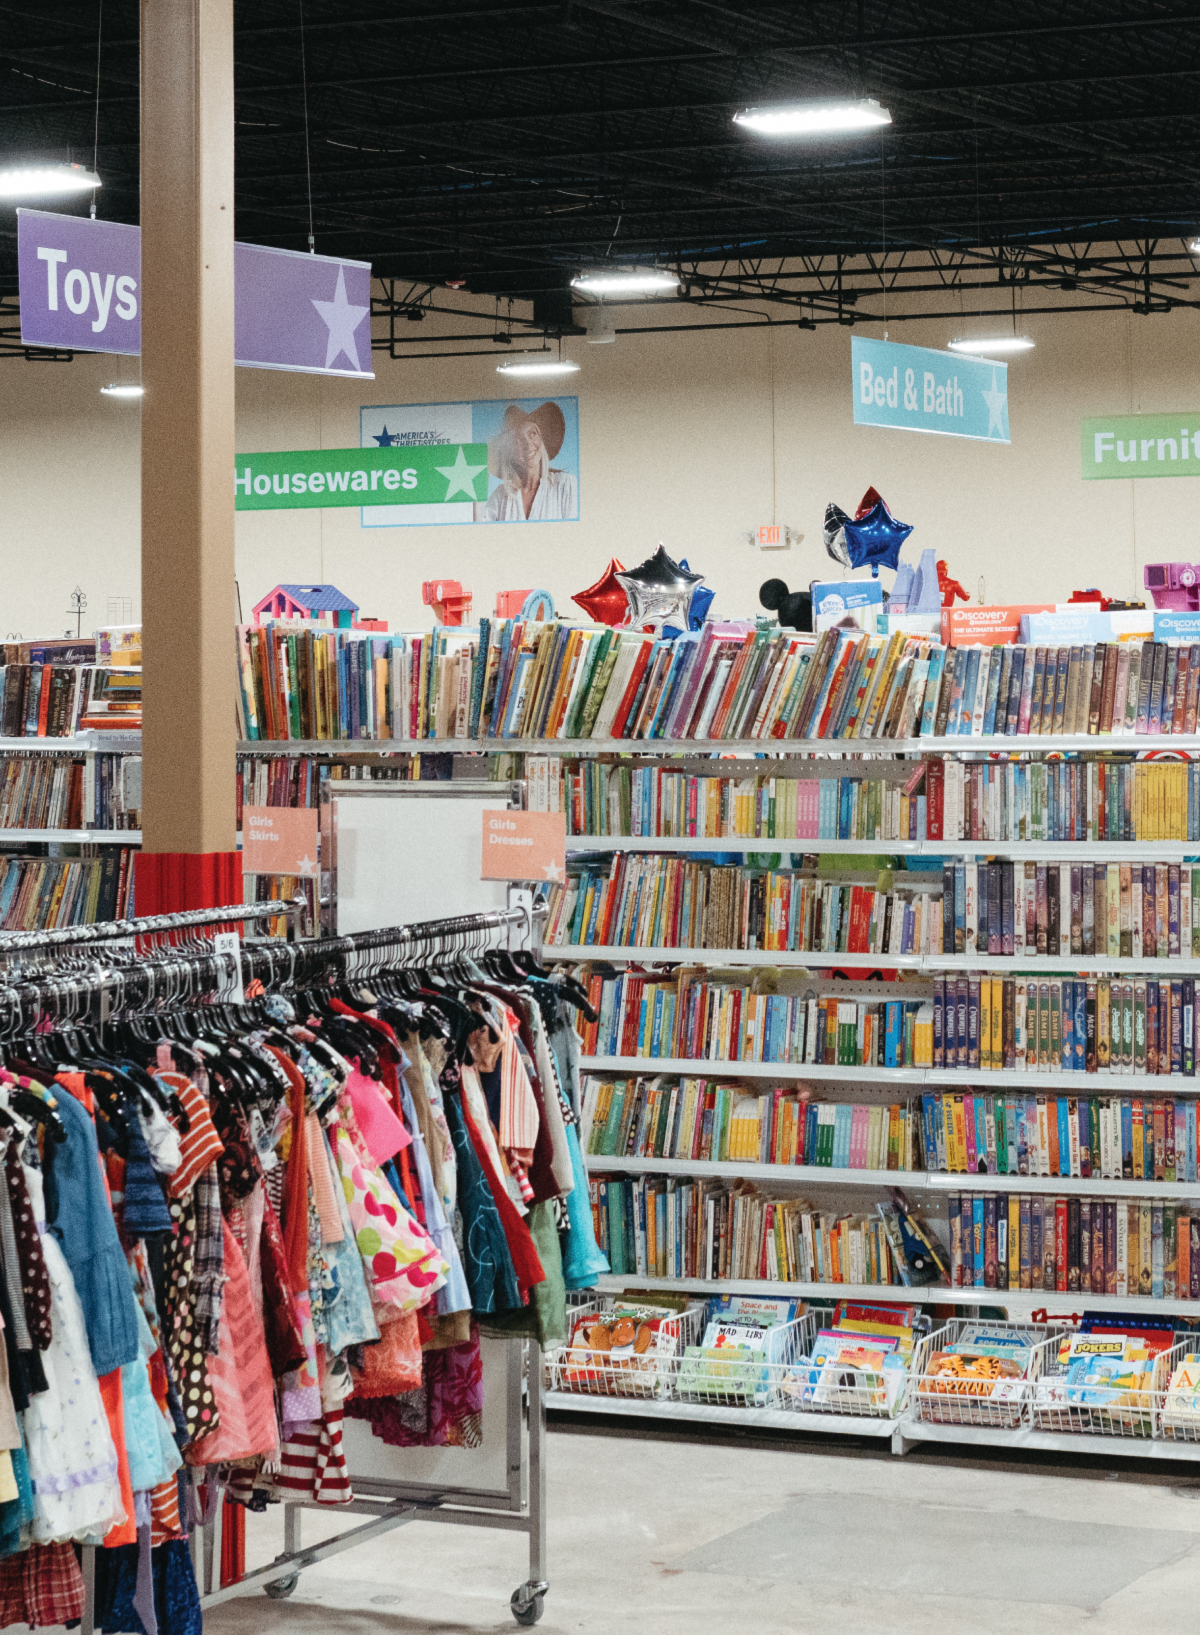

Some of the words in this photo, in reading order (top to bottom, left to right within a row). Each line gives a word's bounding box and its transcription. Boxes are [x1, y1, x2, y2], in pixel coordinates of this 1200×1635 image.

[37, 246, 138, 333] Toys
[860, 361, 898, 410] Bed
[903, 368, 920, 412] &
[923, 372, 964, 418] Bath
[395, 430, 435, 441] AMERICA'S
[1094, 431, 1200, 465] Furnit
[234, 466, 418, 497] Housewares
[760, 525, 782, 544] EXIT
[952, 610, 1008, 622] Discovery
[350, 643, 358, 674] SHAPES
[1046, 676, 1054, 692] Peter
[1138, 680, 1151, 706] FANTASIA
[1150, 680, 1163, 707] FANTASIA
[29, 683, 39, 726] DIVERGENT
[1033, 690, 1042, 703] Pan
[1044, 692, 1052, 704] Pan
[1057, 690, 1065, 703] Pan
[781, 694, 796, 722] ANIMALS
[538, 761, 546, 782] Baby
[550, 760, 558, 780] Baby
[249, 816, 273, 828] Girls
[489, 818, 516, 830] Girls
[249, 830, 280, 842] Skirts
[489, 833, 534, 846] Dresses
[516, 894, 524, 903] 4
[1144, 888, 1154, 922] Aladdin
[220, 939, 234, 950] 5/6
[934, 1004, 942, 1038] CINDERELLA
[946, 1005, 954, 1038] CINDERELLA
[958, 1004, 966, 1036] CINDERELLA
[1086, 1014, 1094, 1038] MULAN
[946, 1110, 954, 1136] HEIDI
[974, 1222, 982, 1238] TOY
[1046, 1216, 1054, 1228] FREE
[986, 1219, 996, 1254] Aladdin
[1046, 1230, 1054, 1246] WILLY
[1082, 1230, 1090, 1244] Lady
[1094, 1223, 1104, 1258] Aladdin
[740, 1301, 762, 1310] Space
[718, 1327, 737, 1336] MAD
[745, 1330, 764, 1340] LIBS
[1074, 1342, 1123, 1354] JOKERS
[1176, 1369, 1194, 1388] A
